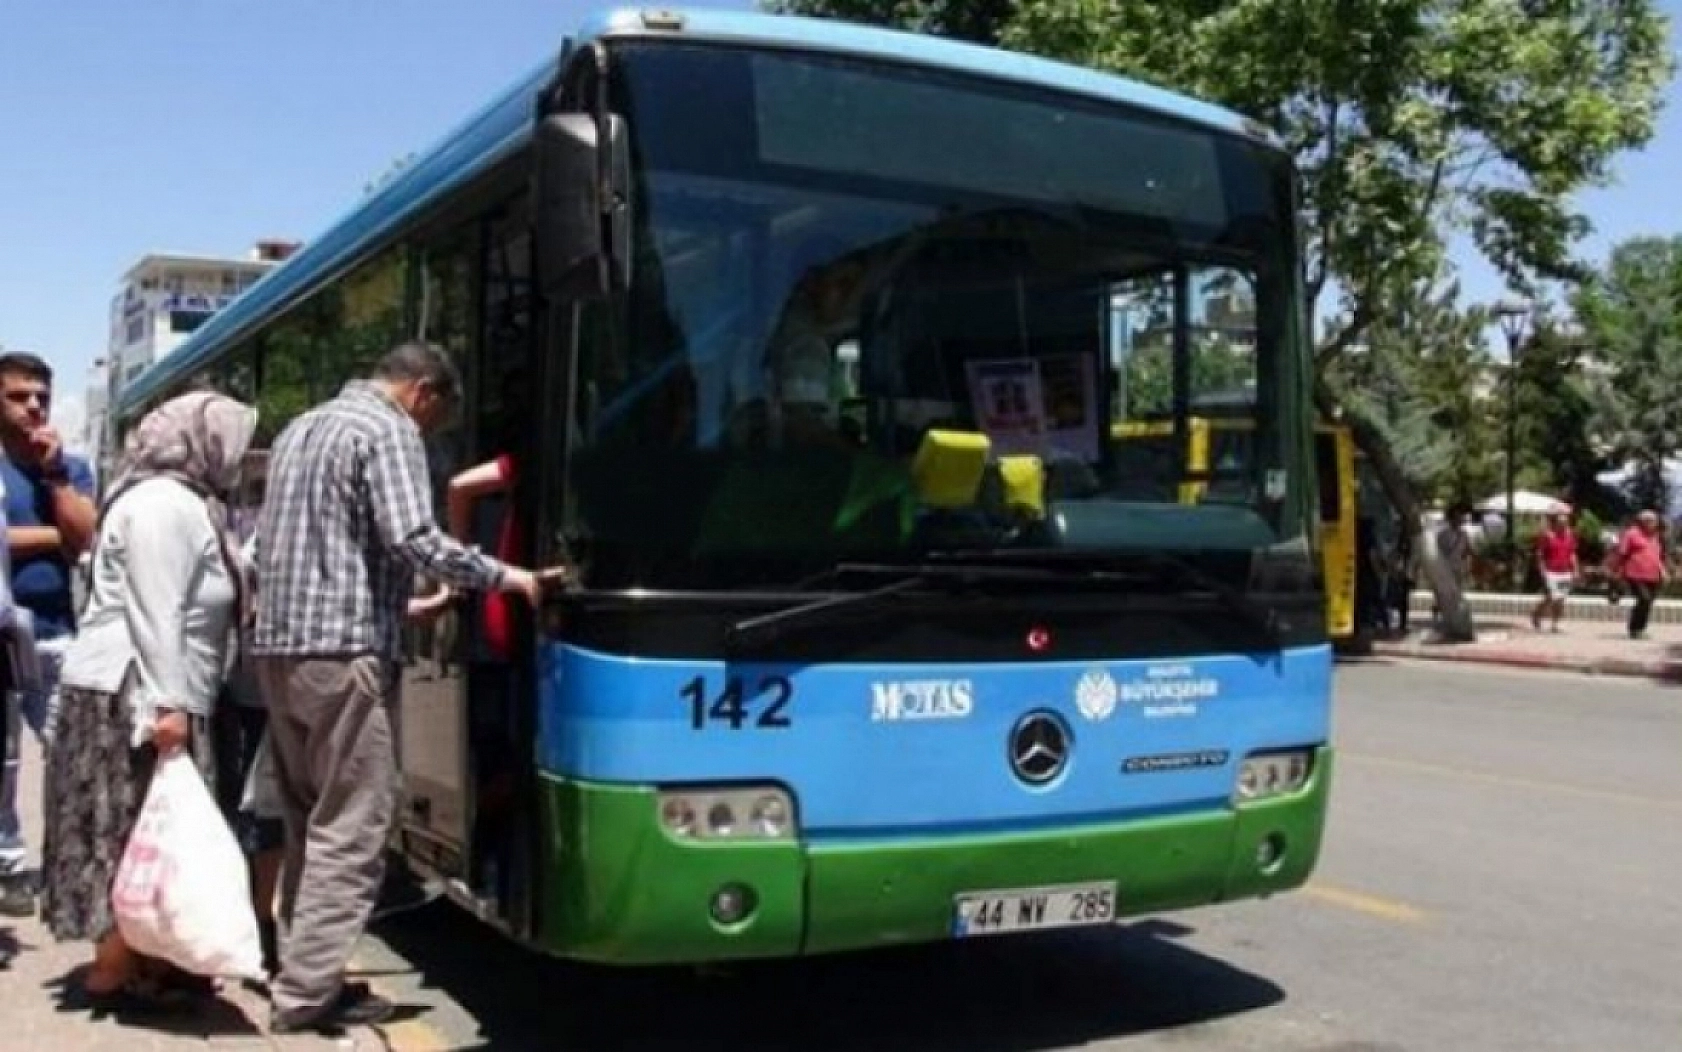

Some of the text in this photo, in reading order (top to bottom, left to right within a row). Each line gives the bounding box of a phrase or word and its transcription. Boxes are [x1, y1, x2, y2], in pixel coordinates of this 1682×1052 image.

[680, 675, 792, 729] 142
[974, 900, 1004, 927] 44
[1070, 889, 1111, 920] 285
